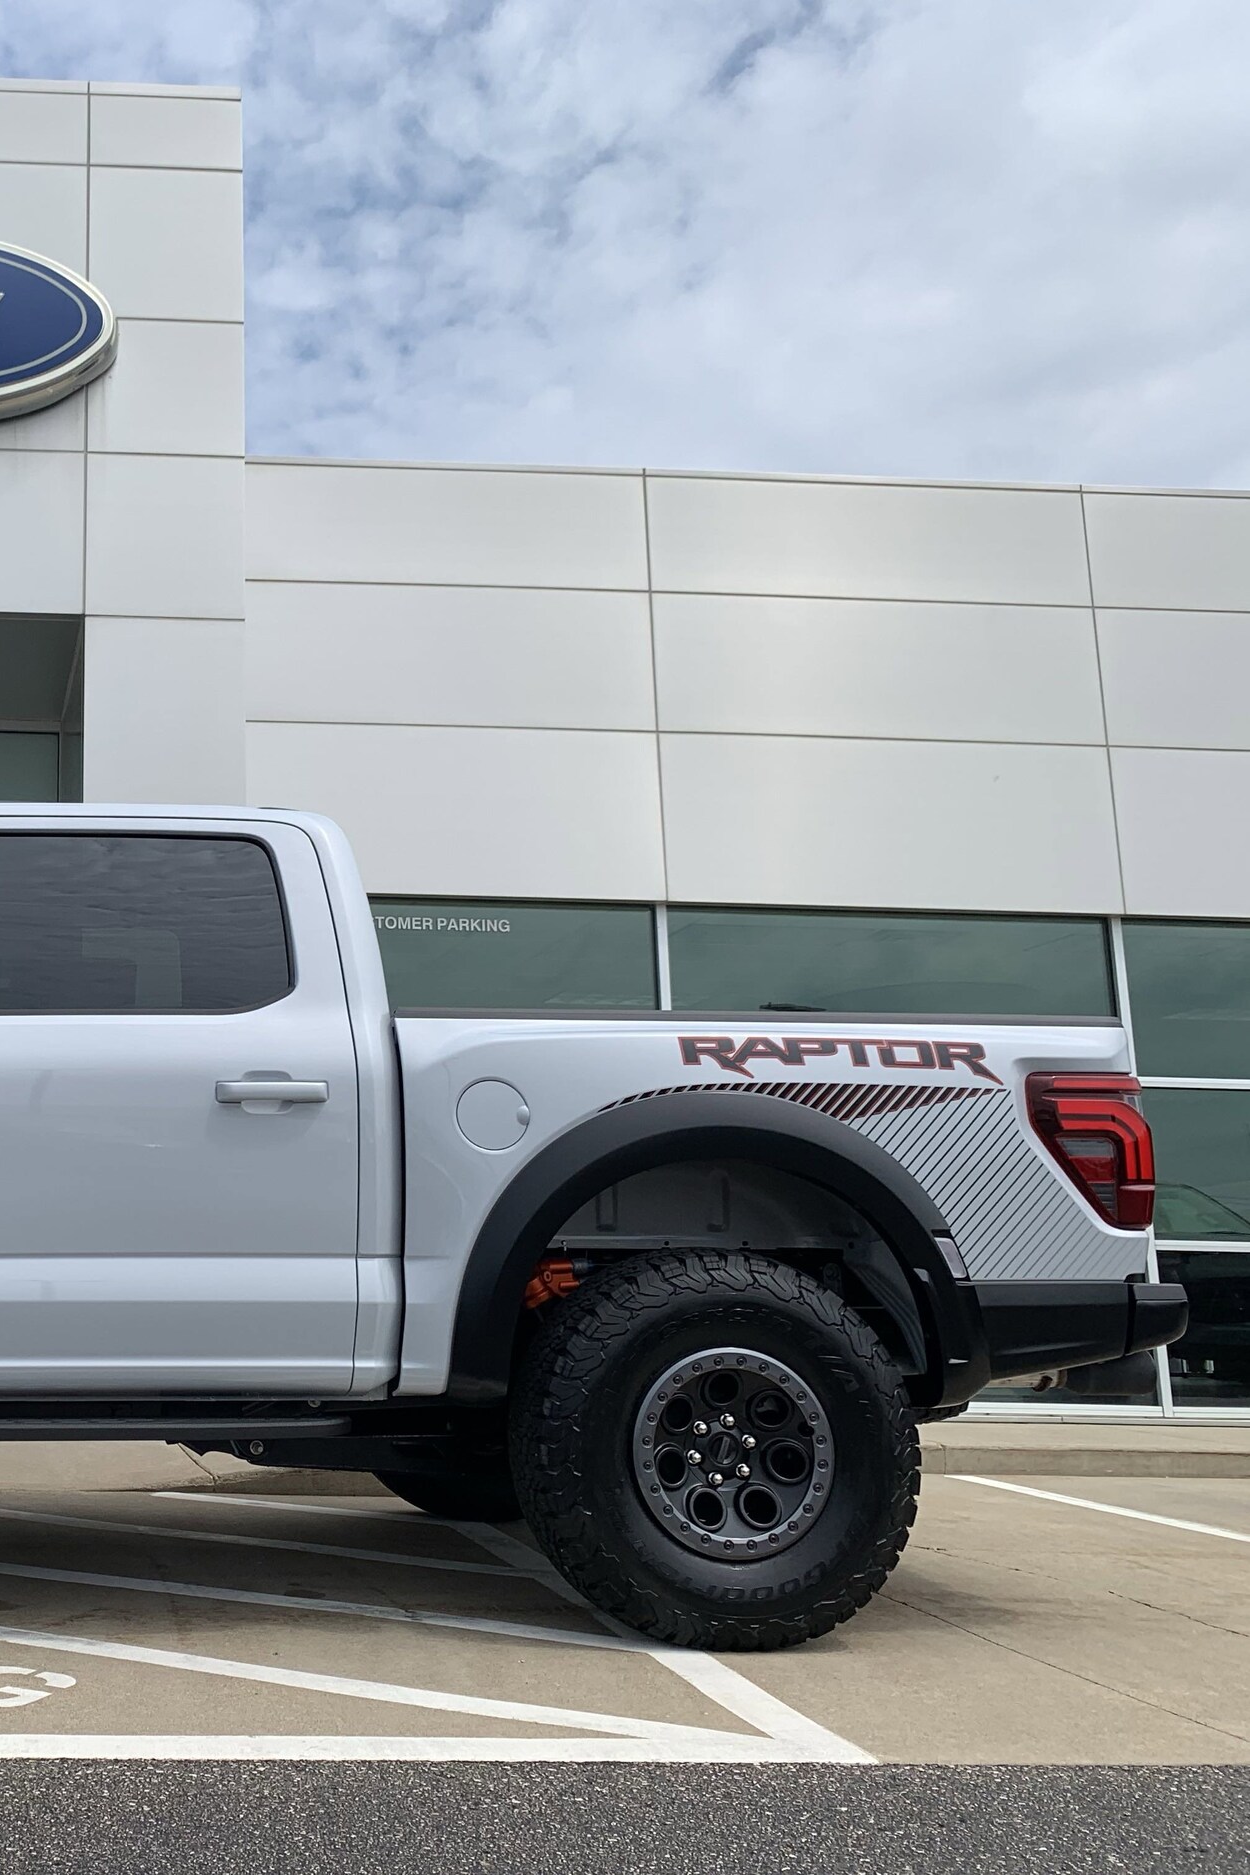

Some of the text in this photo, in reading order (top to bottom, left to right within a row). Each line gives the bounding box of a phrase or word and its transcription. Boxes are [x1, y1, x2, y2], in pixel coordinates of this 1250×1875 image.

[372, 916, 511, 933] TOMER PARKING
[678, 1036, 1004, 1086] RAPTOR
